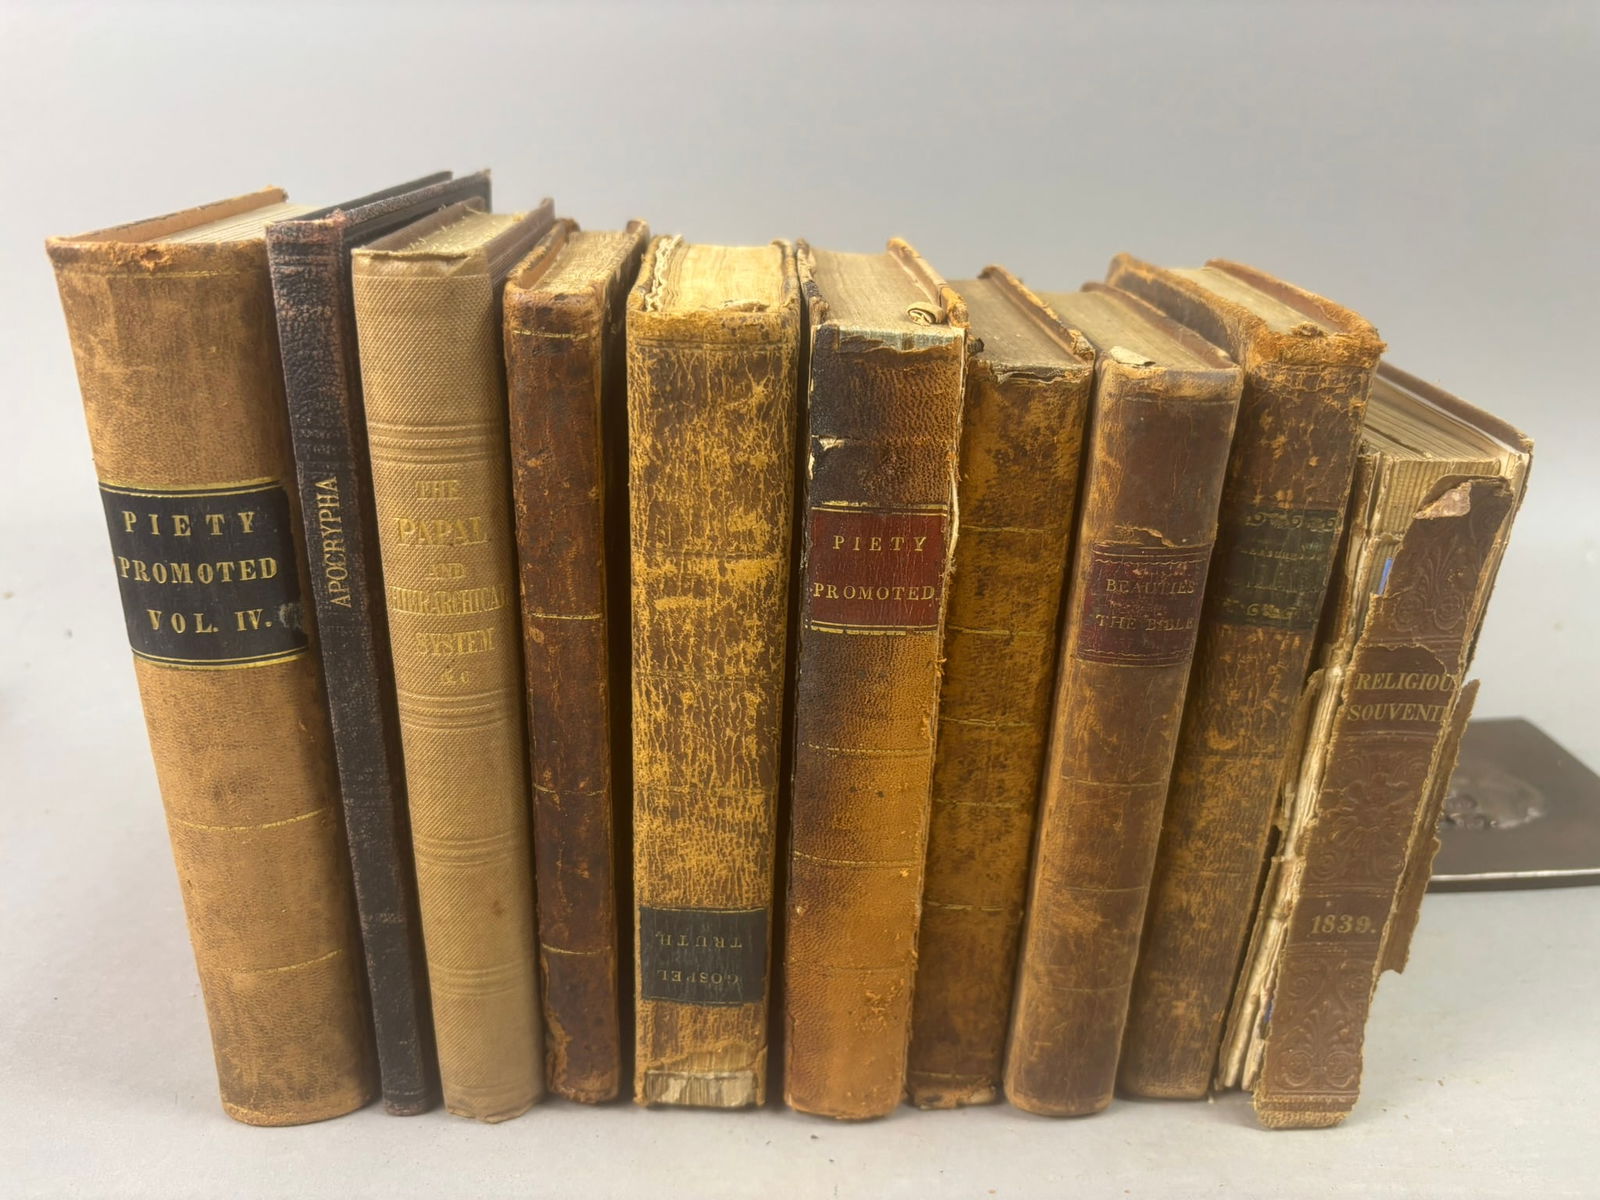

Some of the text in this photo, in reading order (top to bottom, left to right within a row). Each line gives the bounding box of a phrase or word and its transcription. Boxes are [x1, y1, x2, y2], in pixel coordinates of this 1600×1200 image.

[122, 511, 256, 537] PIETY
[392, 516, 490, 546] PAPAL
[314, 476, 352, 608] APOCRYPHA
[832, 535, 926, 552] PIETY
[118, 555, 279, 585] PROMOTED
[147, 608, 273, 634] VOL. IV.
[1096, 614, 1137, 631] THE
[1353, 672, 1453, 692] RELIGIOU
[1311, 914, 1377, 934] 1839.
[657, 970, 741, 985] GOSPEL
